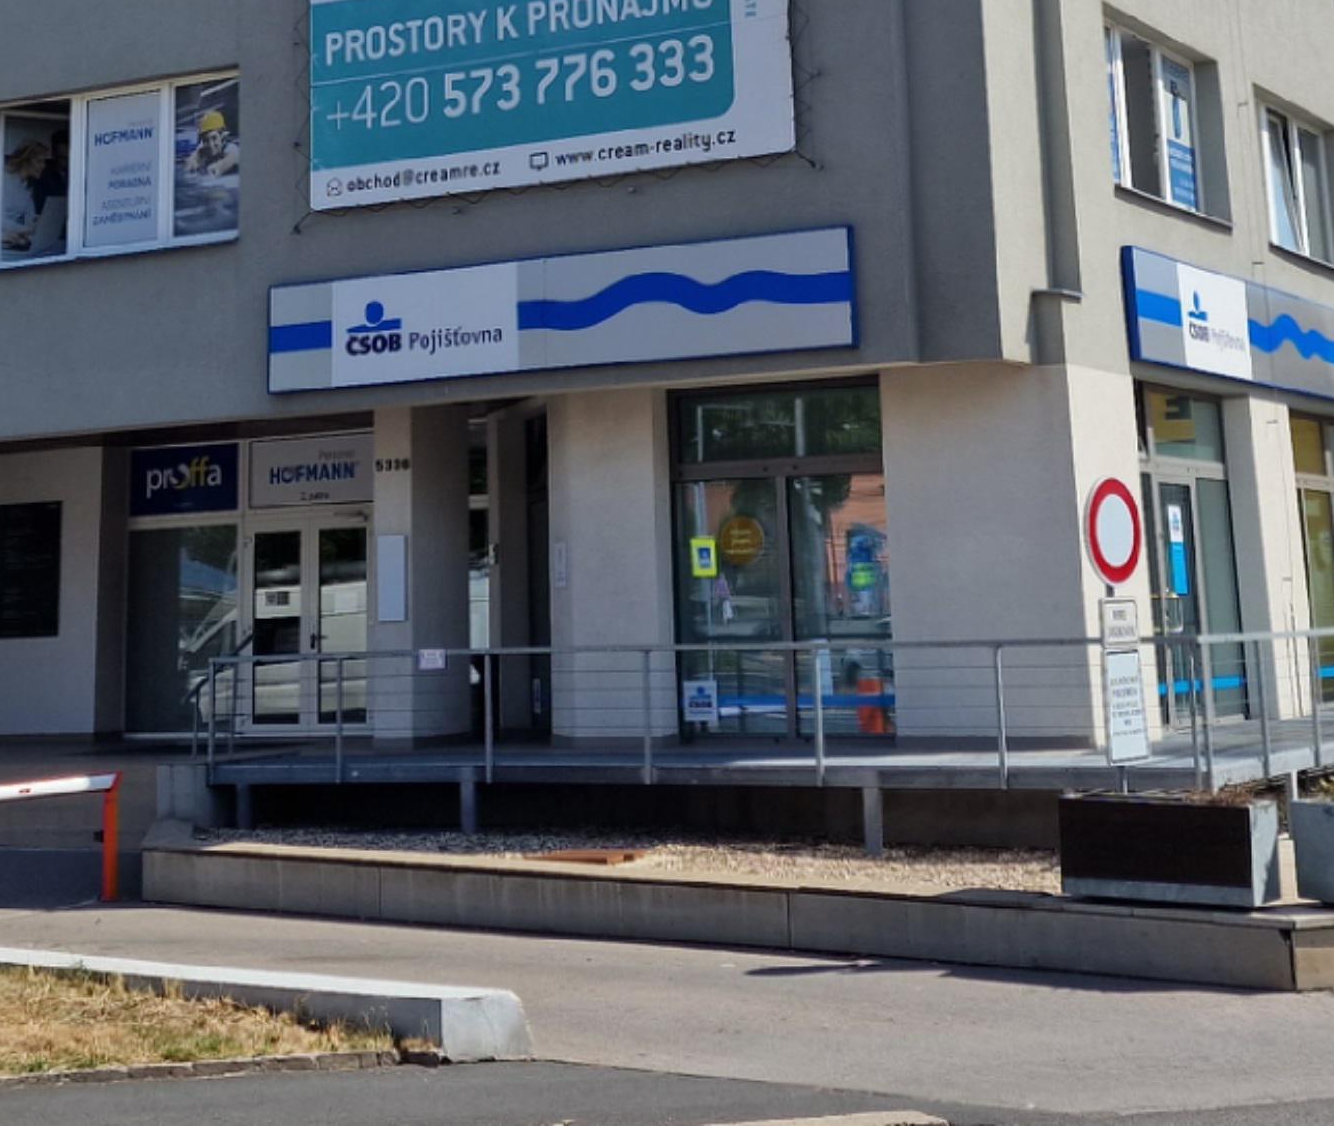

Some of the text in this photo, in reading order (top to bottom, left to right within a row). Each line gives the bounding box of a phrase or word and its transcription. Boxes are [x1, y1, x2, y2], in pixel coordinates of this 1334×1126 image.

[325, 10, 488, 67] PROSTORY
[496, 5, 519, 41] K
[326, 34, 715, 131] +420 573 776 333
[555, 128, 737, 168] www.cream-reality.cz
[346, 160, 501, 193] obchod@creamre.cz
[345, 325, 503, 356] ČSOB Pojišťovna
[269, 460, 356, 485] HOFMANN
